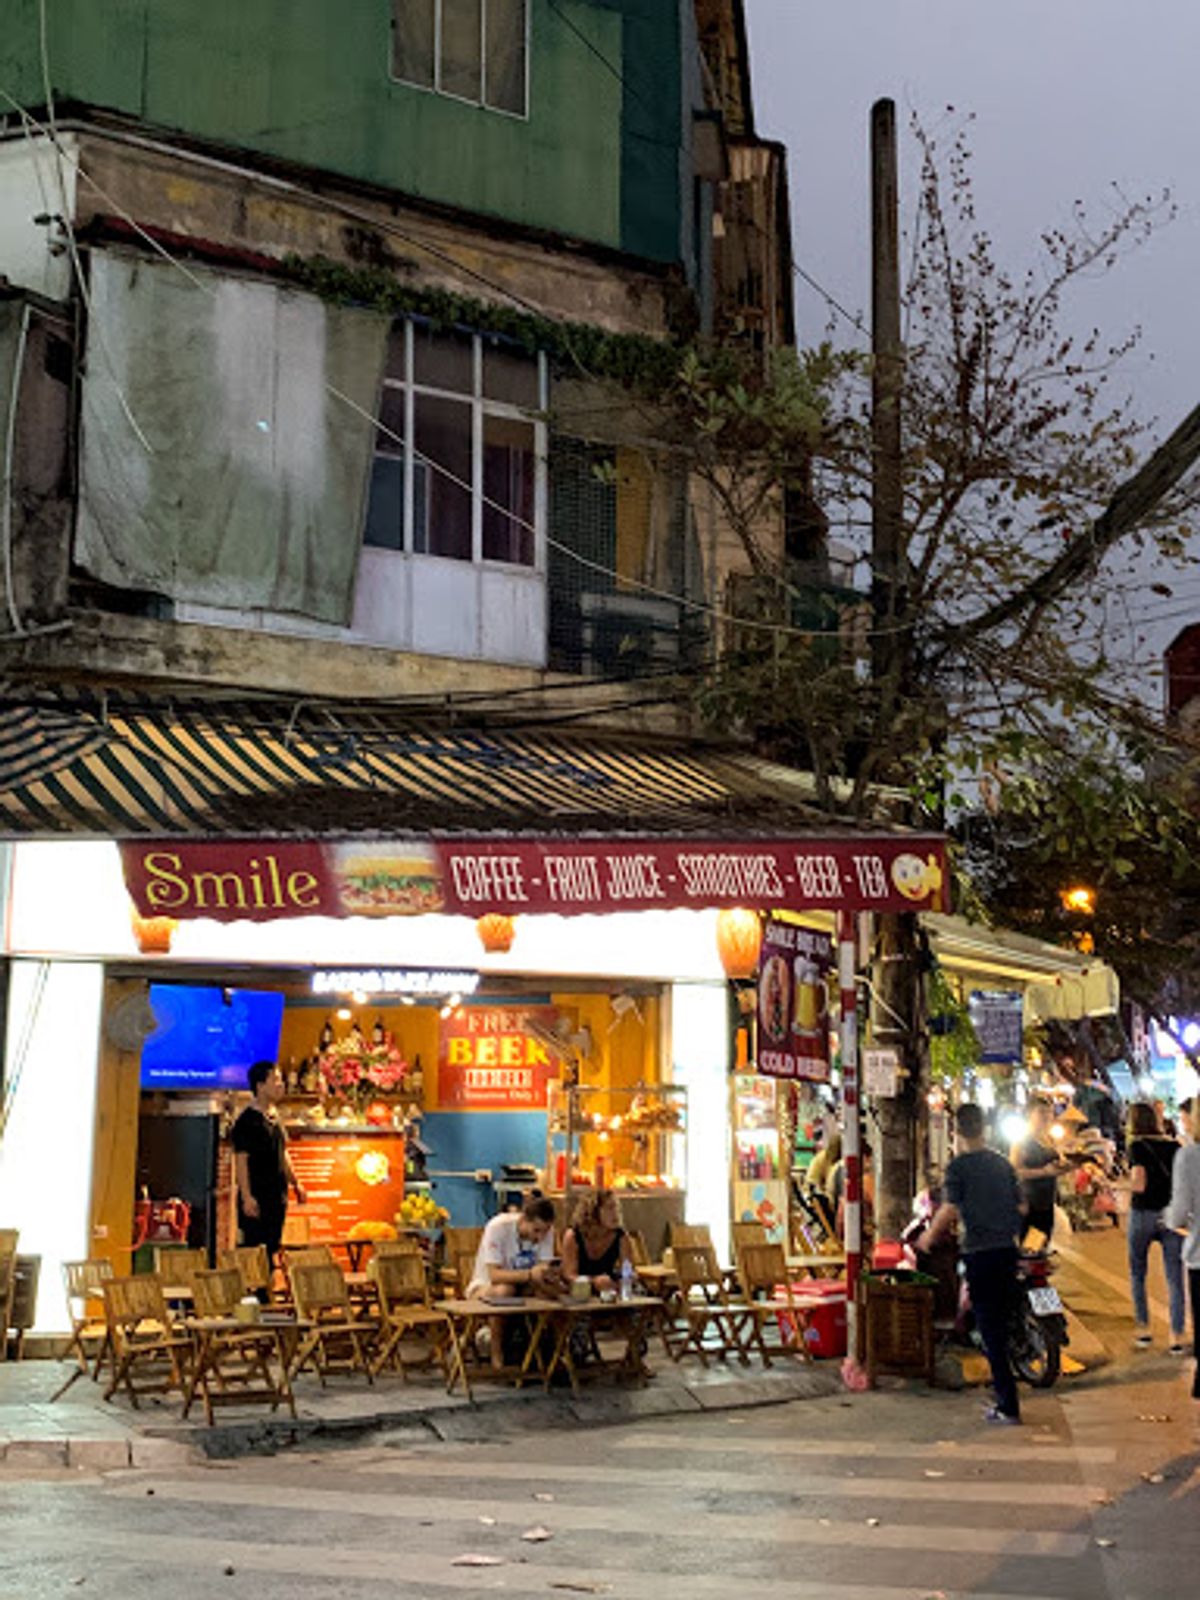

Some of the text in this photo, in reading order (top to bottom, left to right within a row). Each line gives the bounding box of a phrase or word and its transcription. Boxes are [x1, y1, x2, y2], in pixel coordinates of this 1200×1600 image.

[143, 852, 321, 908] Smile
[450, 855, 529, 901] COFFEE
[544, 855, 601, 901] FRUIT
[606, 854, 666, 899] JUICE
[677, 854, 785, 897] SMOOTHIES
[796, 855, 843, 898] BEER
[853, 856, 889, 898] TEA
[760, 1050, 795, 1076] COLD
